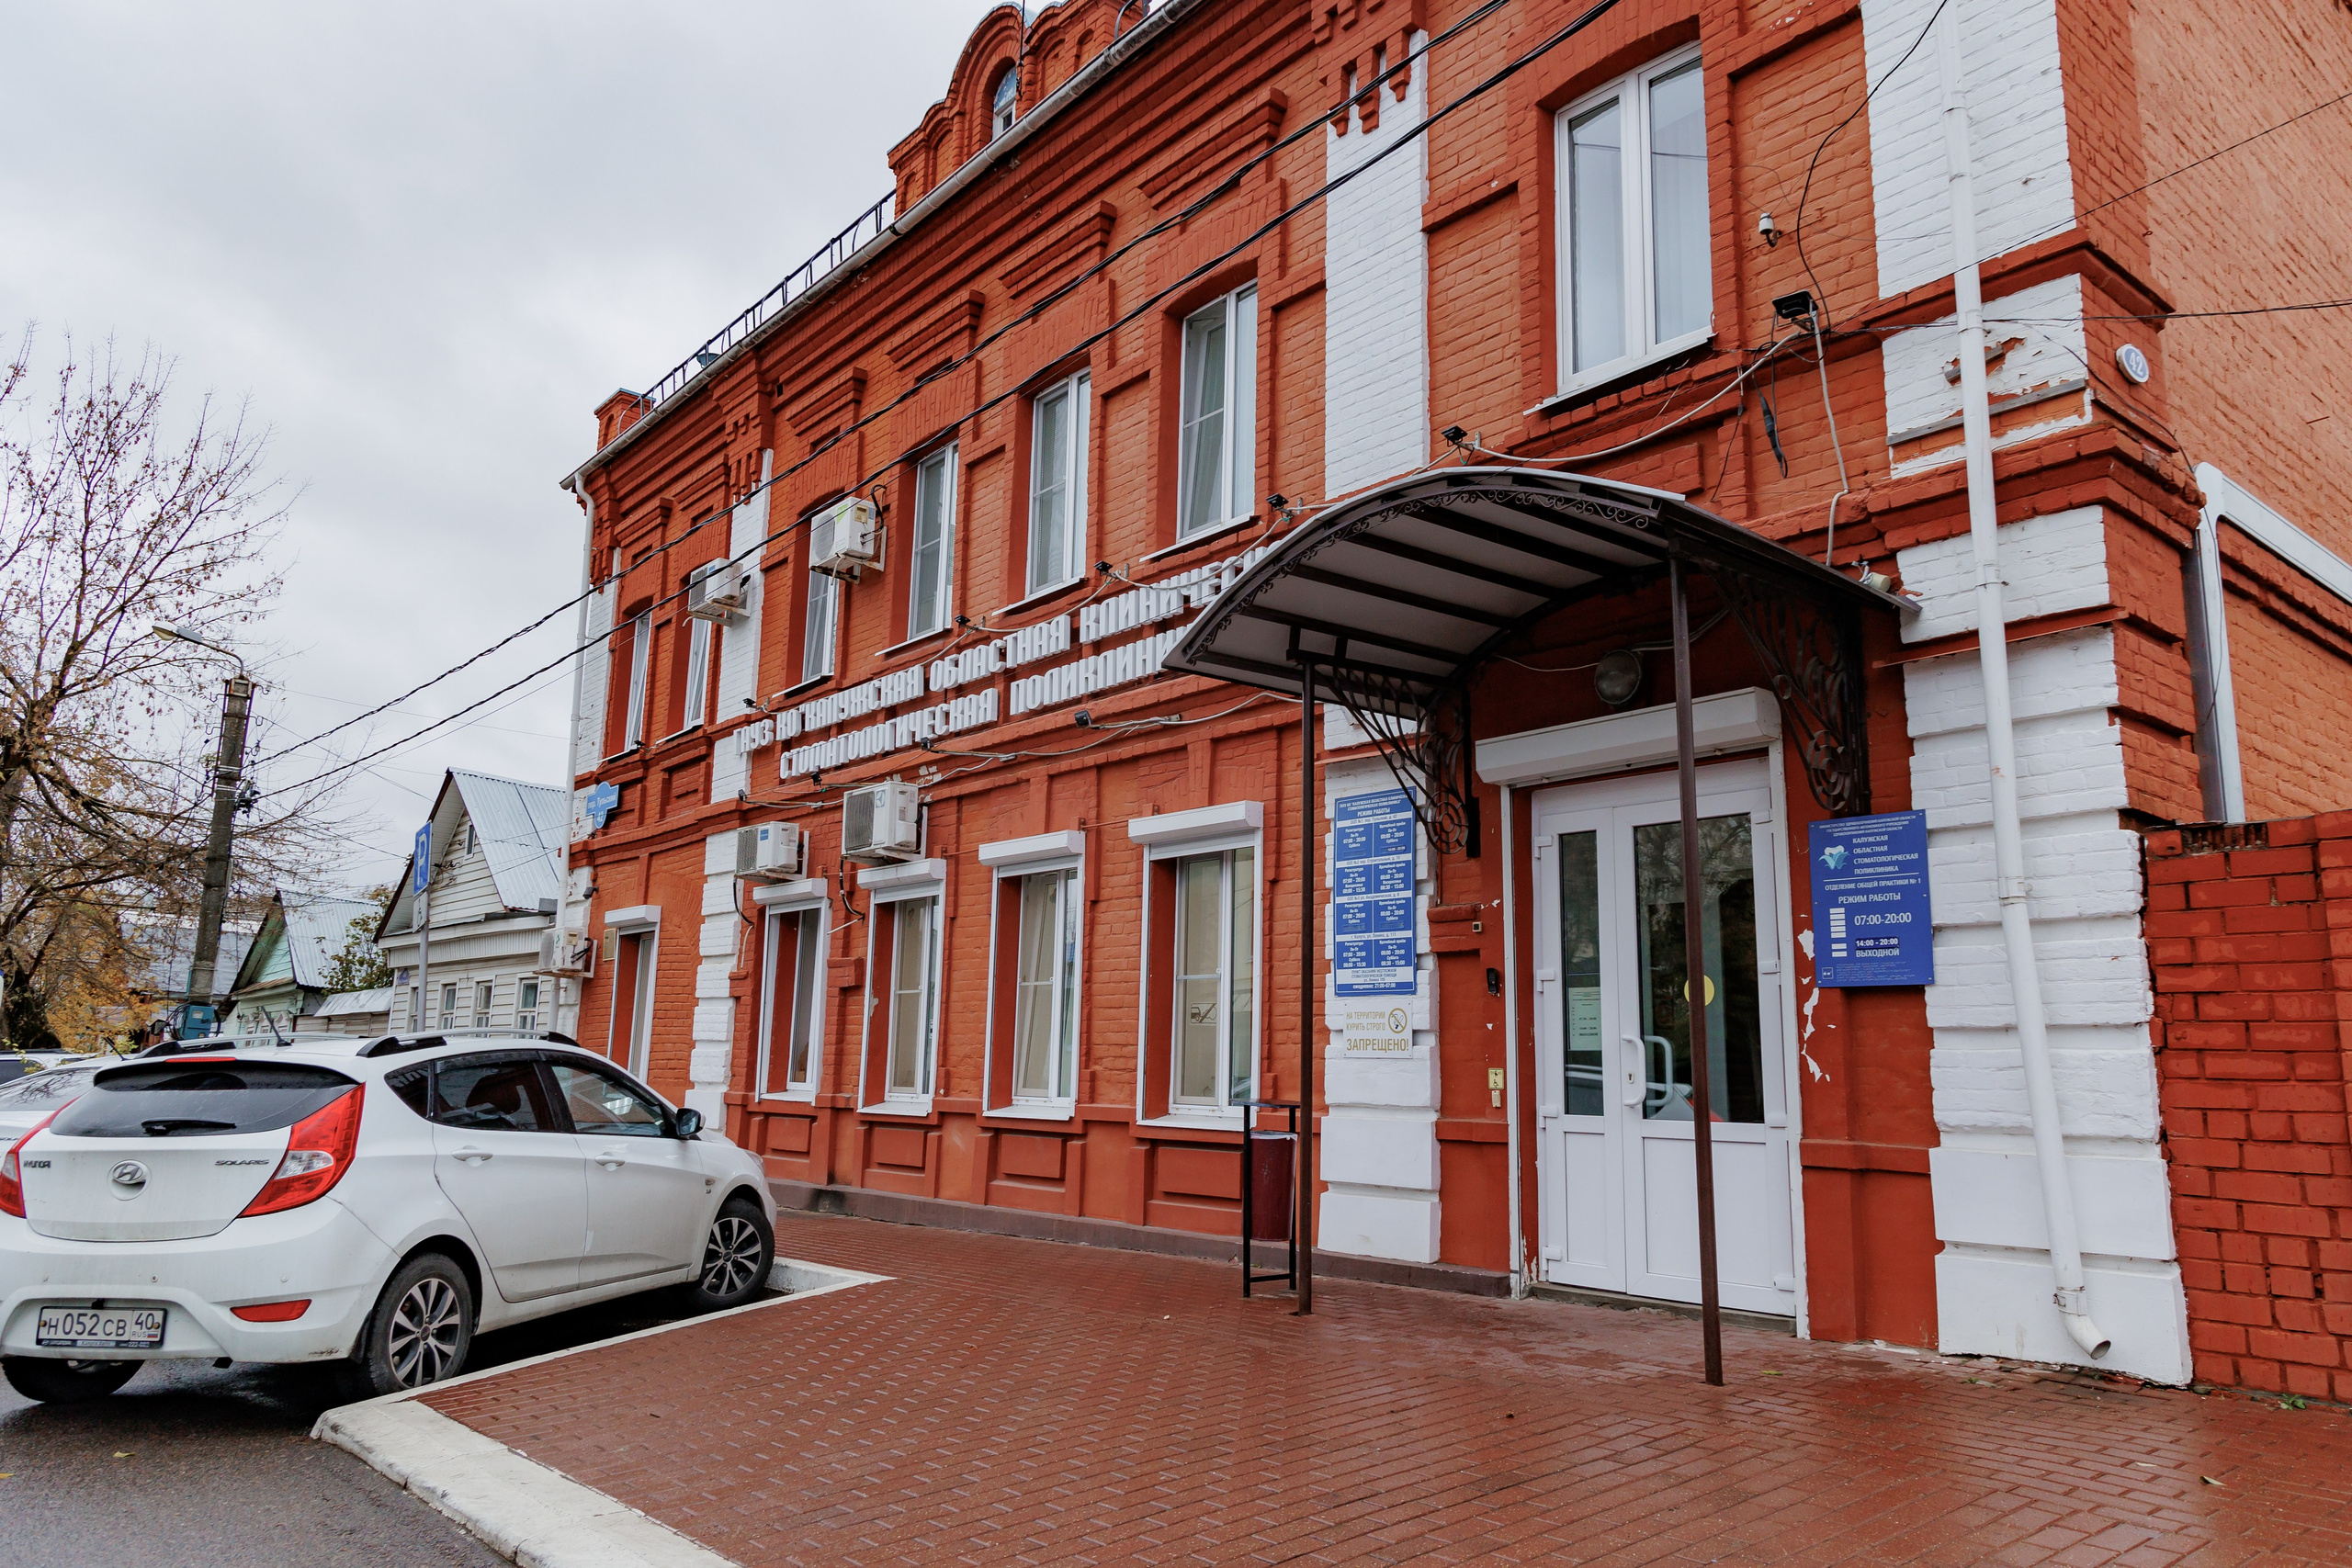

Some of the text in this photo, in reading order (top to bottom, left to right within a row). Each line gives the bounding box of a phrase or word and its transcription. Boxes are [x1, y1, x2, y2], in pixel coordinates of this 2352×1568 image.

[2129, 352, 2144, 376] 42
[733, 718, 774, 755] ГАУЗ
[929, 615, 1070, 692] ОБЛАСТНАЯ
[780, 688, 999, 779] СТОМАТОЛОГИЧЕСКАЯ
[1853, 835, 1888, 844] КАЛУЖСКАЯ
[1853, 845, 1888, 854] ОБЛАСТНАЯ
[1854, 853, 1918, 864] СТОМАТОЛОГИЧЕСКАЯ
[1854, 866, 1899, 875] ПОЛИКЛИНИКА
[1838, 893, 1901, 904] РЕЖИМ РАБОТЫ
[1854, 912, 1912, 925] 07:00-20:00
[1856, 948, 1899, 957] ВЫХОДНОЙ
[1346, 1038, 1409, 1053] ЗАПРЕЩЕНО!
[135, 1312, 155, 1330] 40
